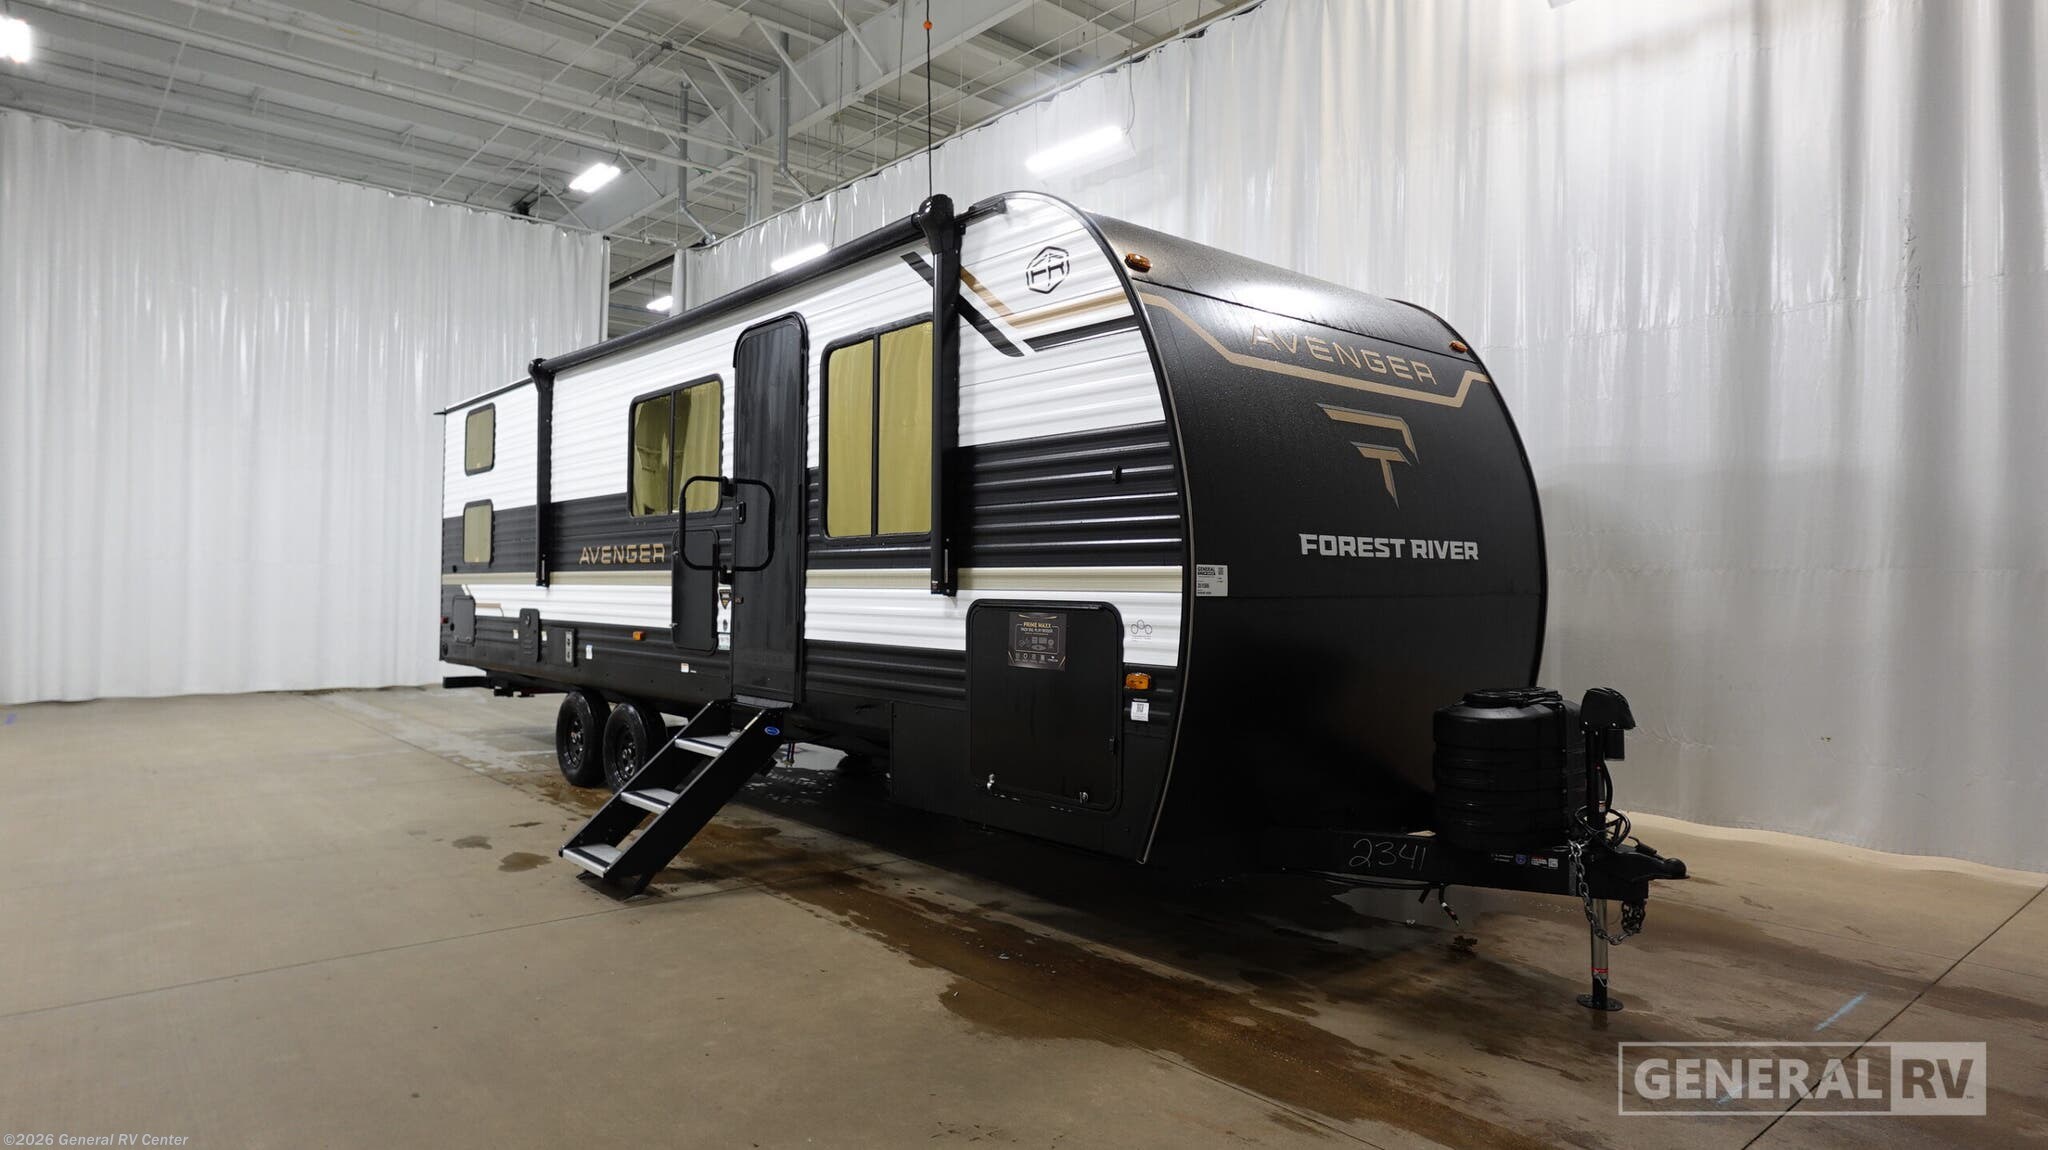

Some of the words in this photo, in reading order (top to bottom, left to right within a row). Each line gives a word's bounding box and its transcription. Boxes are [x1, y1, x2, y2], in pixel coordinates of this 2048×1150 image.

[1250, 324, 1438, 386] AVENGER
[578, 543, 665, 565] AVENGER
[1299, 533, 1406, 559] FOREST
[1409, 539, 1480, 561] RIVER
[1349, 838, 1427, 872] 2341
